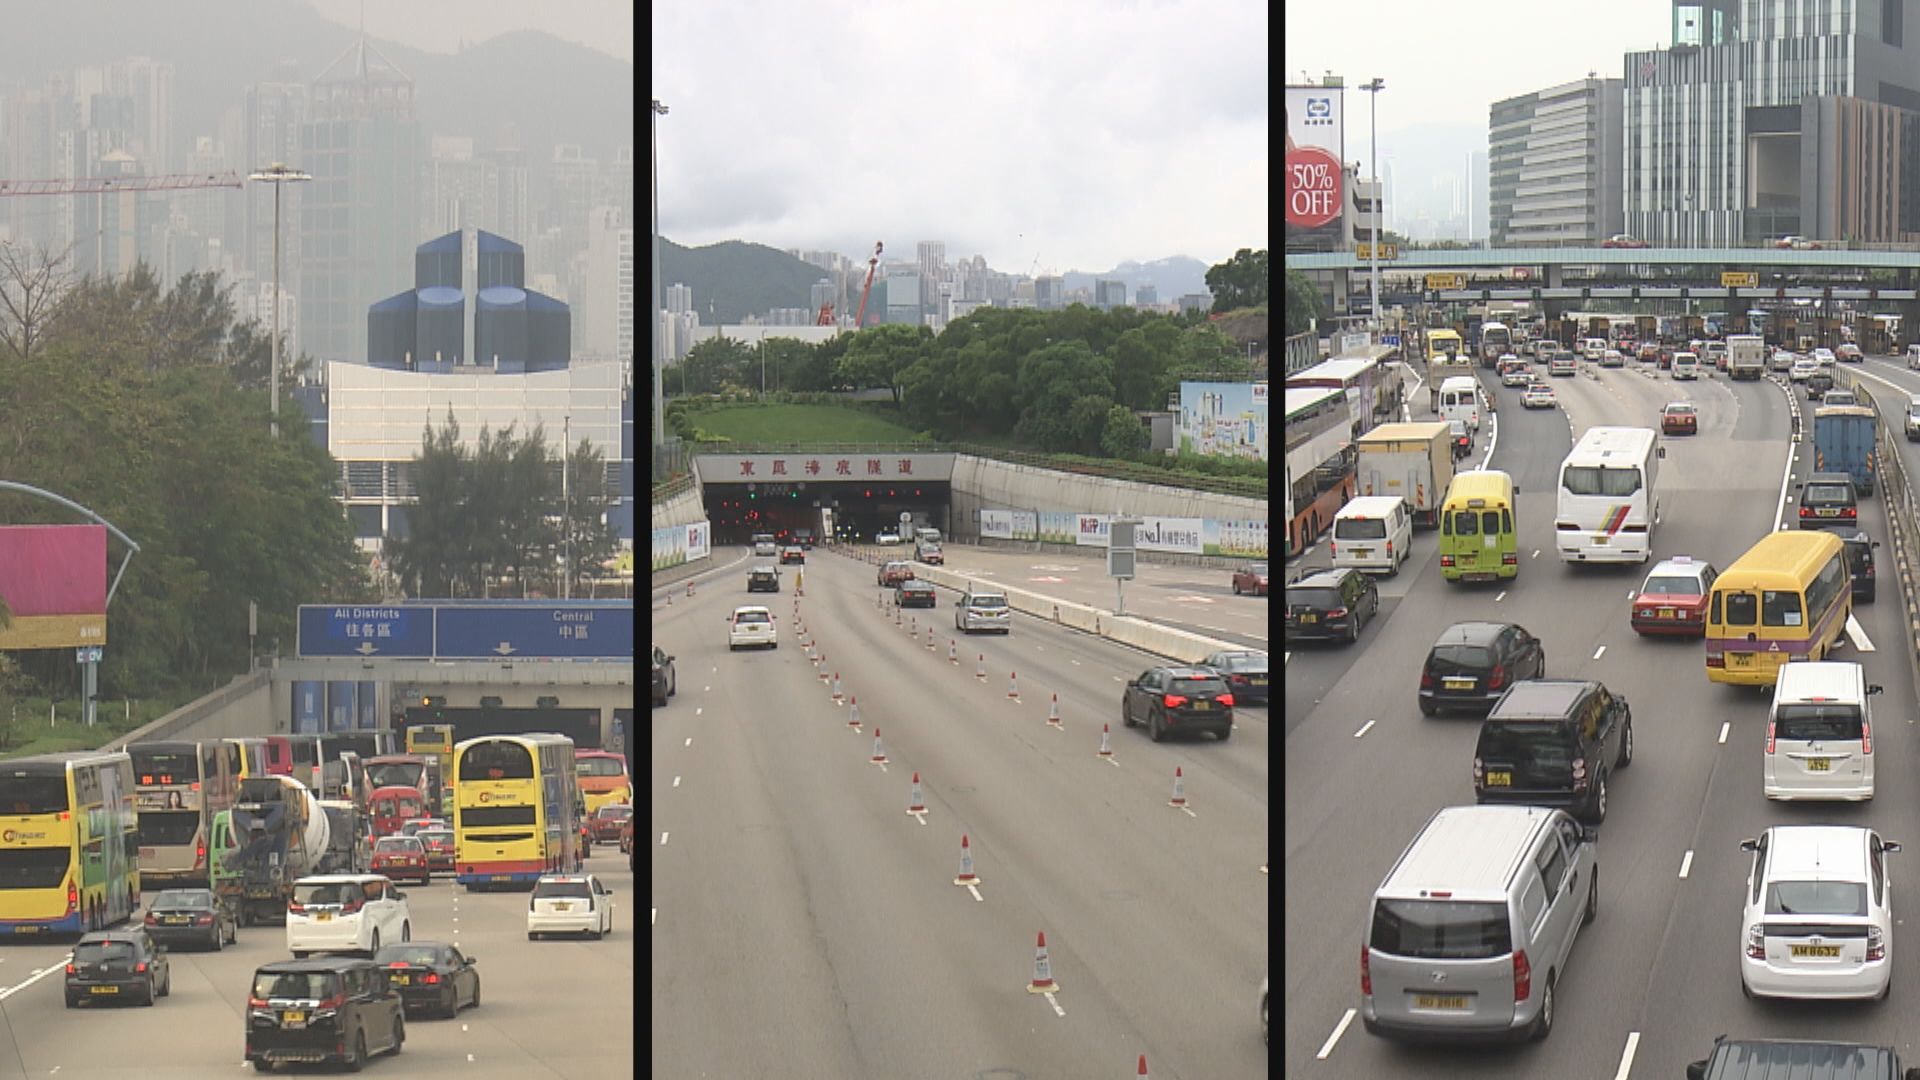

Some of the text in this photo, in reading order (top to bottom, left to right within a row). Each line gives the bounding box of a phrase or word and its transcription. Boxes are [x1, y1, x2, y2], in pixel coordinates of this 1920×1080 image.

[1292, 163, 1334, 190] 50%
[1291, 190, 1334, 216] OFF
[740, 459, 912, 476] 東區海底隧道
[335, 607, 400, 619] All Districts
[553, 610, 593, 622] Central
[346, 623, 391, 638] 往各區
[559, 623, 589, 640] 中區
